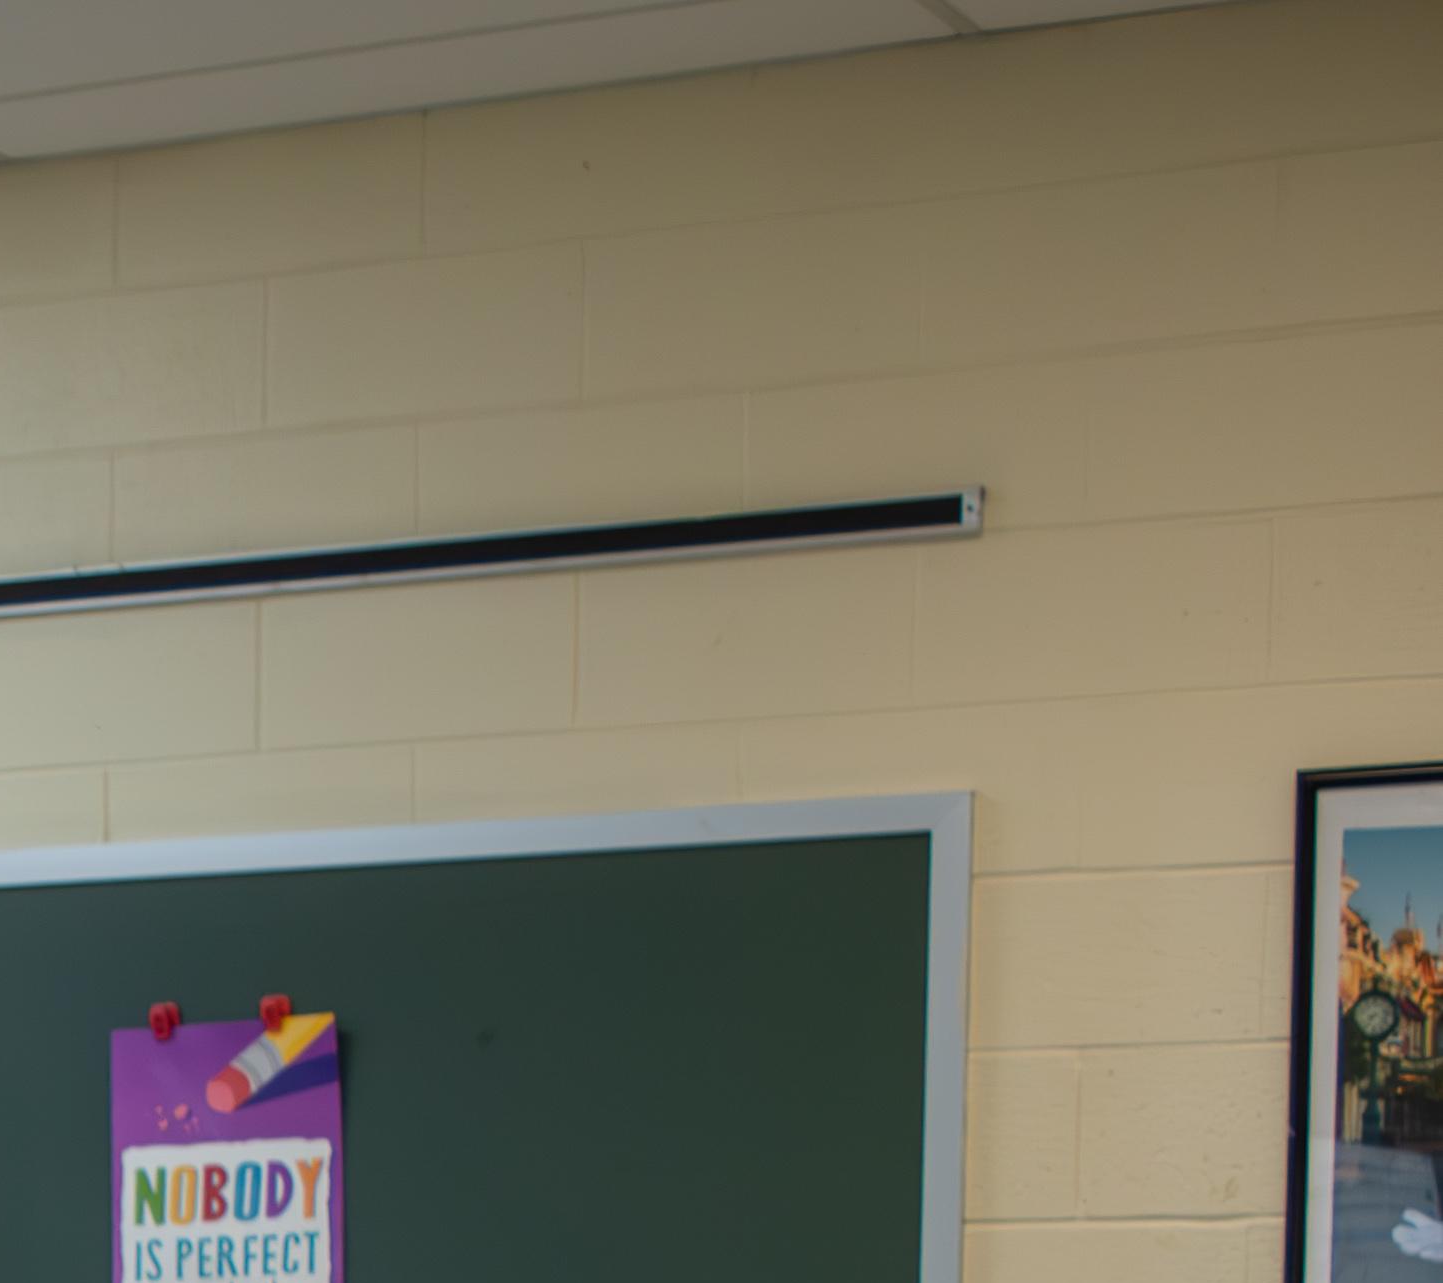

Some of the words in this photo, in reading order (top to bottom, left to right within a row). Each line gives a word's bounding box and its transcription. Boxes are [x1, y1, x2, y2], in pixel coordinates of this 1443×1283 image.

[135, 1157, 323, 1225] NOBODY
[136, 1238, 163, 1281] IS
[176, 1232, 319, 1280] PERFECT
